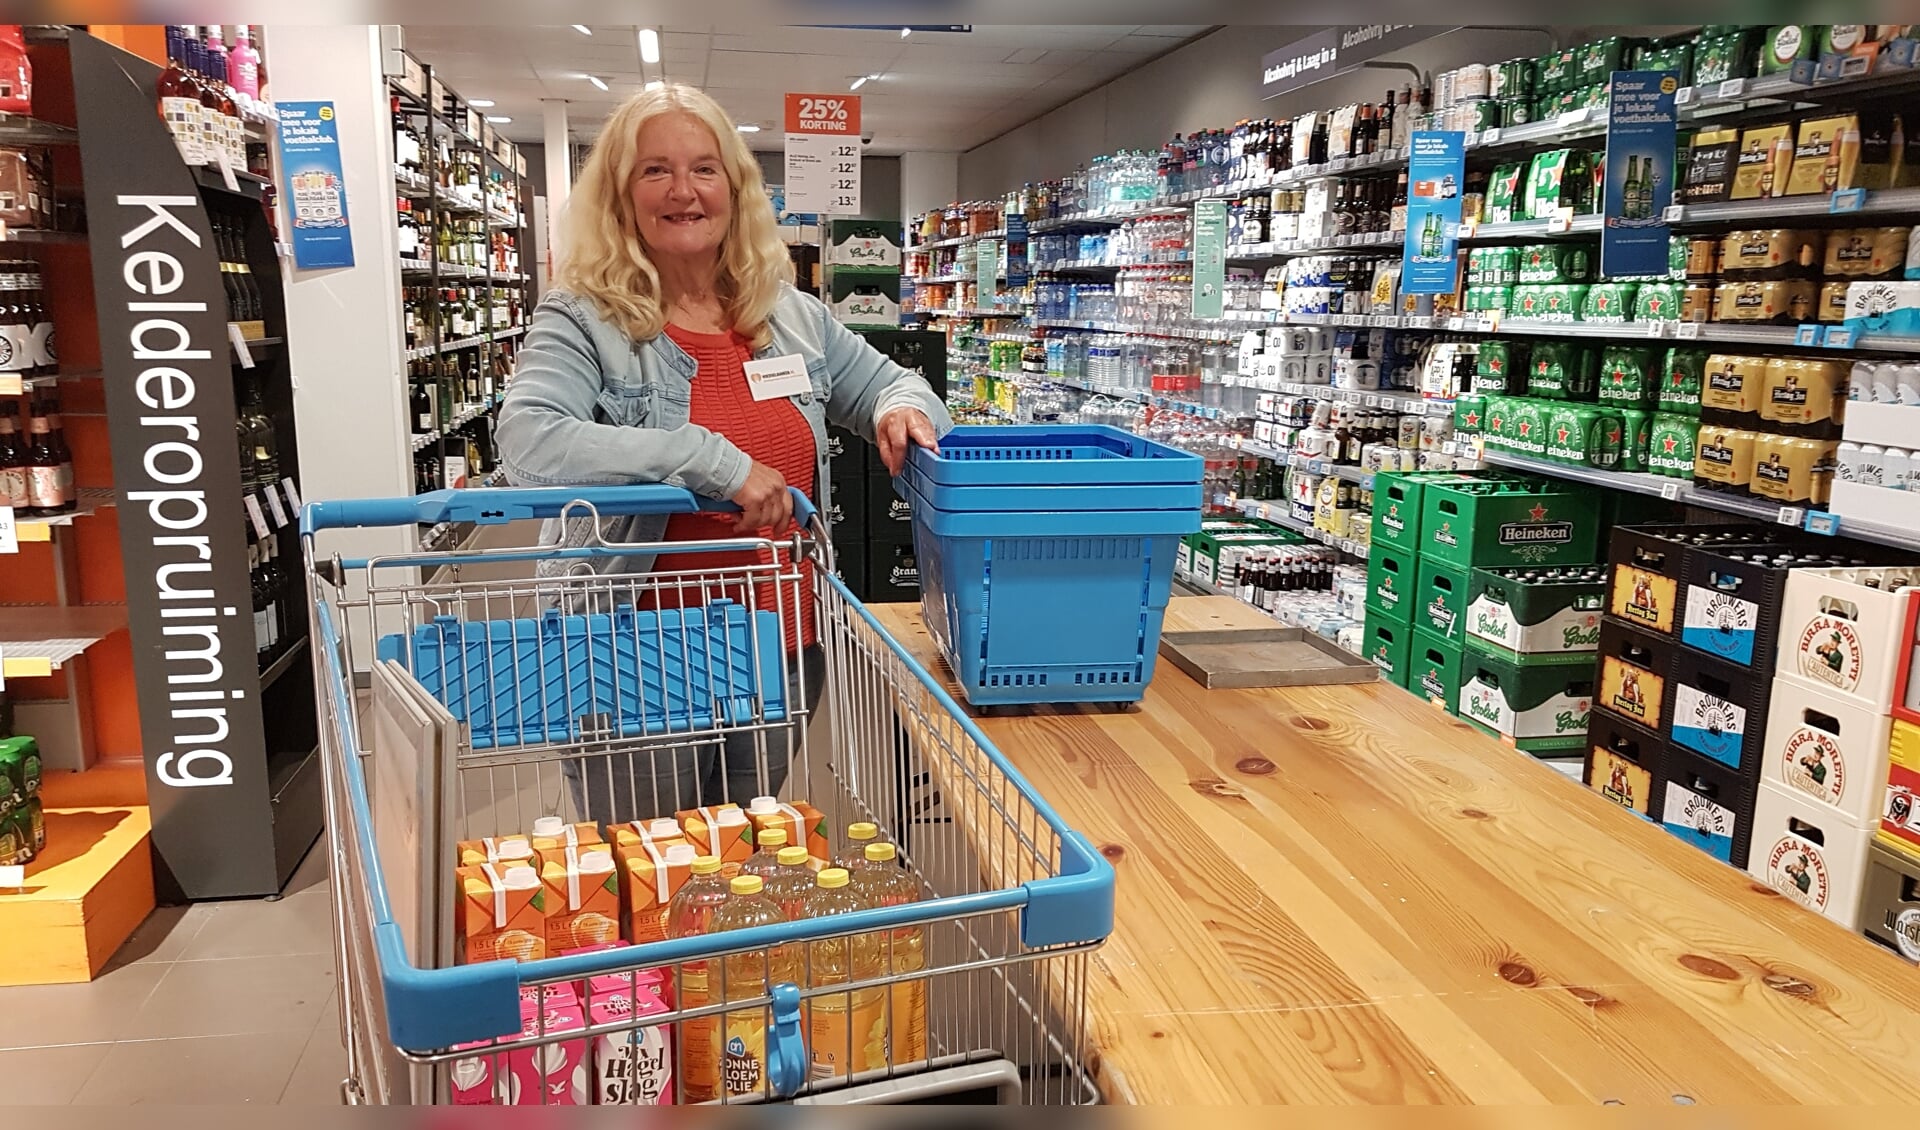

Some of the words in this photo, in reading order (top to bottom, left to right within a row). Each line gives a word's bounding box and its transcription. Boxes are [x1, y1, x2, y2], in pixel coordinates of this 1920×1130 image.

[1296, 57, 1302, 72] &
[1303, 52, 1321, 69] Laag
[1321, 48, 1329, 63] in
[1615, 81, 1645, 92] Spaar
[1615, 93, 1635, 101] mee
[280, 110, 306, 118] Spaar
[798, 98, 848, 120] 25%
[1614, 104, 1622, 114] je
[1625, 102, 1656, 113] lokale
[800, 120, 847, 131] KORTING
[1613, 113, 1672, 124] voetbalclub.
[282, 127, 291, 136] je
[293, 126, 318, 135] lokale
[284, 136, 335, 145] voetbalclub.
[116, 194, 245, 787] Kelderopruiming
[892, 500, 910, 510] Bra
[1292, 505, 1314, 522] Heine
[1505, 526, 1568, 541] Heineken
[892, 566, 918, 576] Bran
[1706, 593, 1748, 627] BROUWERS
[1478, 613, 1507, 639] Grolsch
[1801, 618, 1830, 652] BIRRA
[1833, 620, 1860, 682] MORETTI
[1471, 696, 1499, 723] Grolsch
[1695, 695, 1736, 731] BROUWERS
[1785, 732, 1813, 763] BIRRA
[1816, 734, 1844, 797] MORETTI
[1684, 795, 1725, 834] BROUWERS
[1770, 840, 1798, 869] BIRRA
[1801, 843, 1826, 908] MORETTI
[719, 1059, 759, 1069] ONNE
[726, 1070, 758, 1080] LOEM
